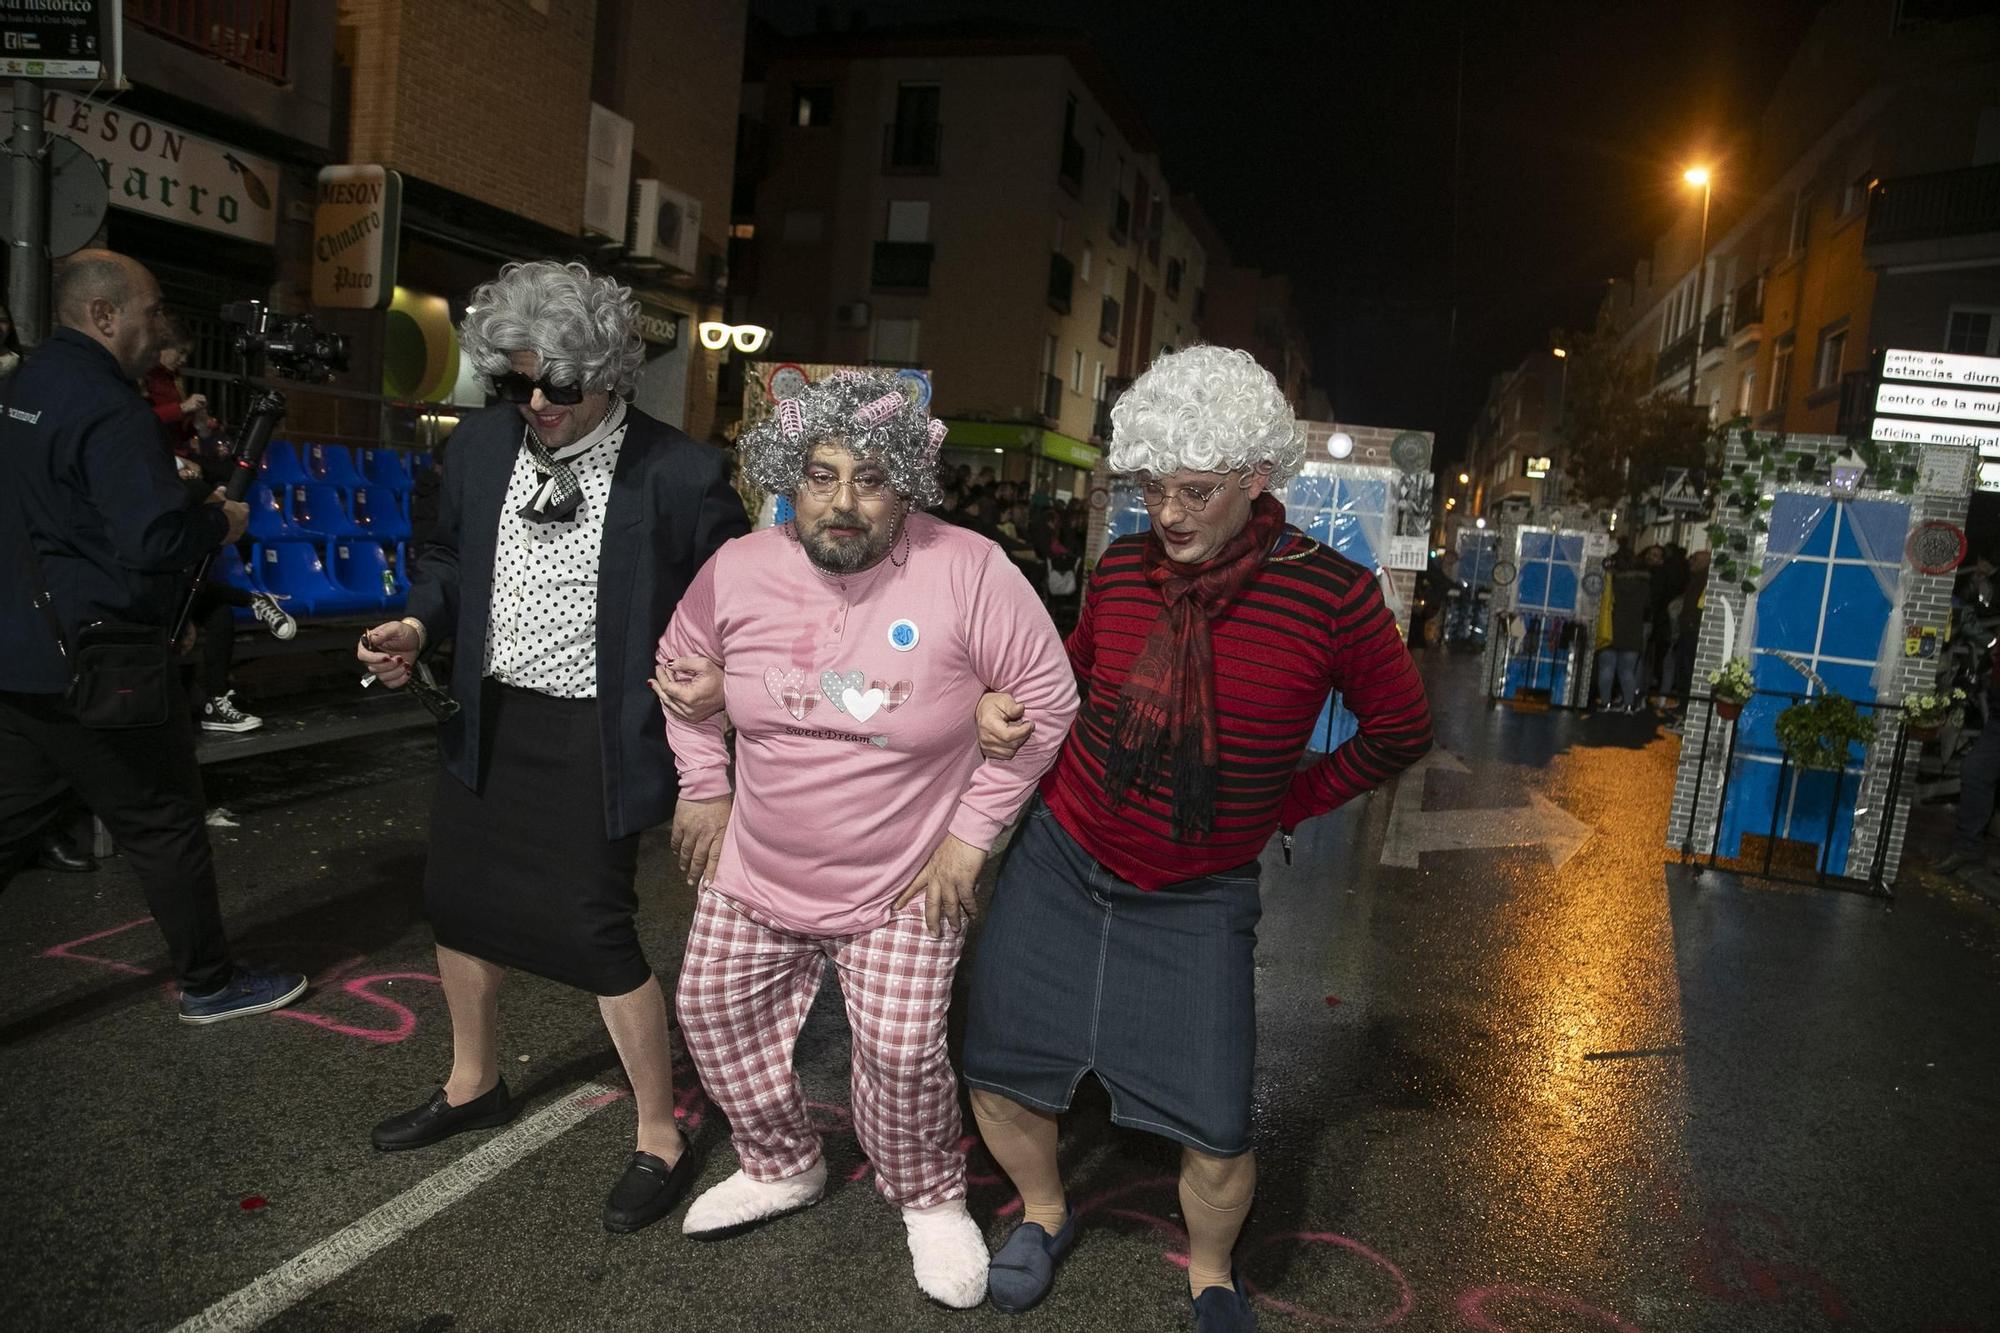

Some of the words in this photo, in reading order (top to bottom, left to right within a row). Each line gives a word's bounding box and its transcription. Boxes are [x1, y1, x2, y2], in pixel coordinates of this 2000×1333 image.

[319, 183, 382, 205] MESON
[317, 210, 380, 263] Chinarro
[334, 266, 372, 293] Paco
[1887, 354, 1924, 365] centro
[1930, 356, 1945, 366] de
[1886, 365, 1954, 380] estancias
[1963, 371, 2000, 385] diurn
[1879, 394, 1926, 407] centro
[1931, 396, 1948, 408] de
[1954, 398, 1967, 410] la
[1874, 426, 1922, 441] oficina
[1930, 433, 1999, 448] municipal
